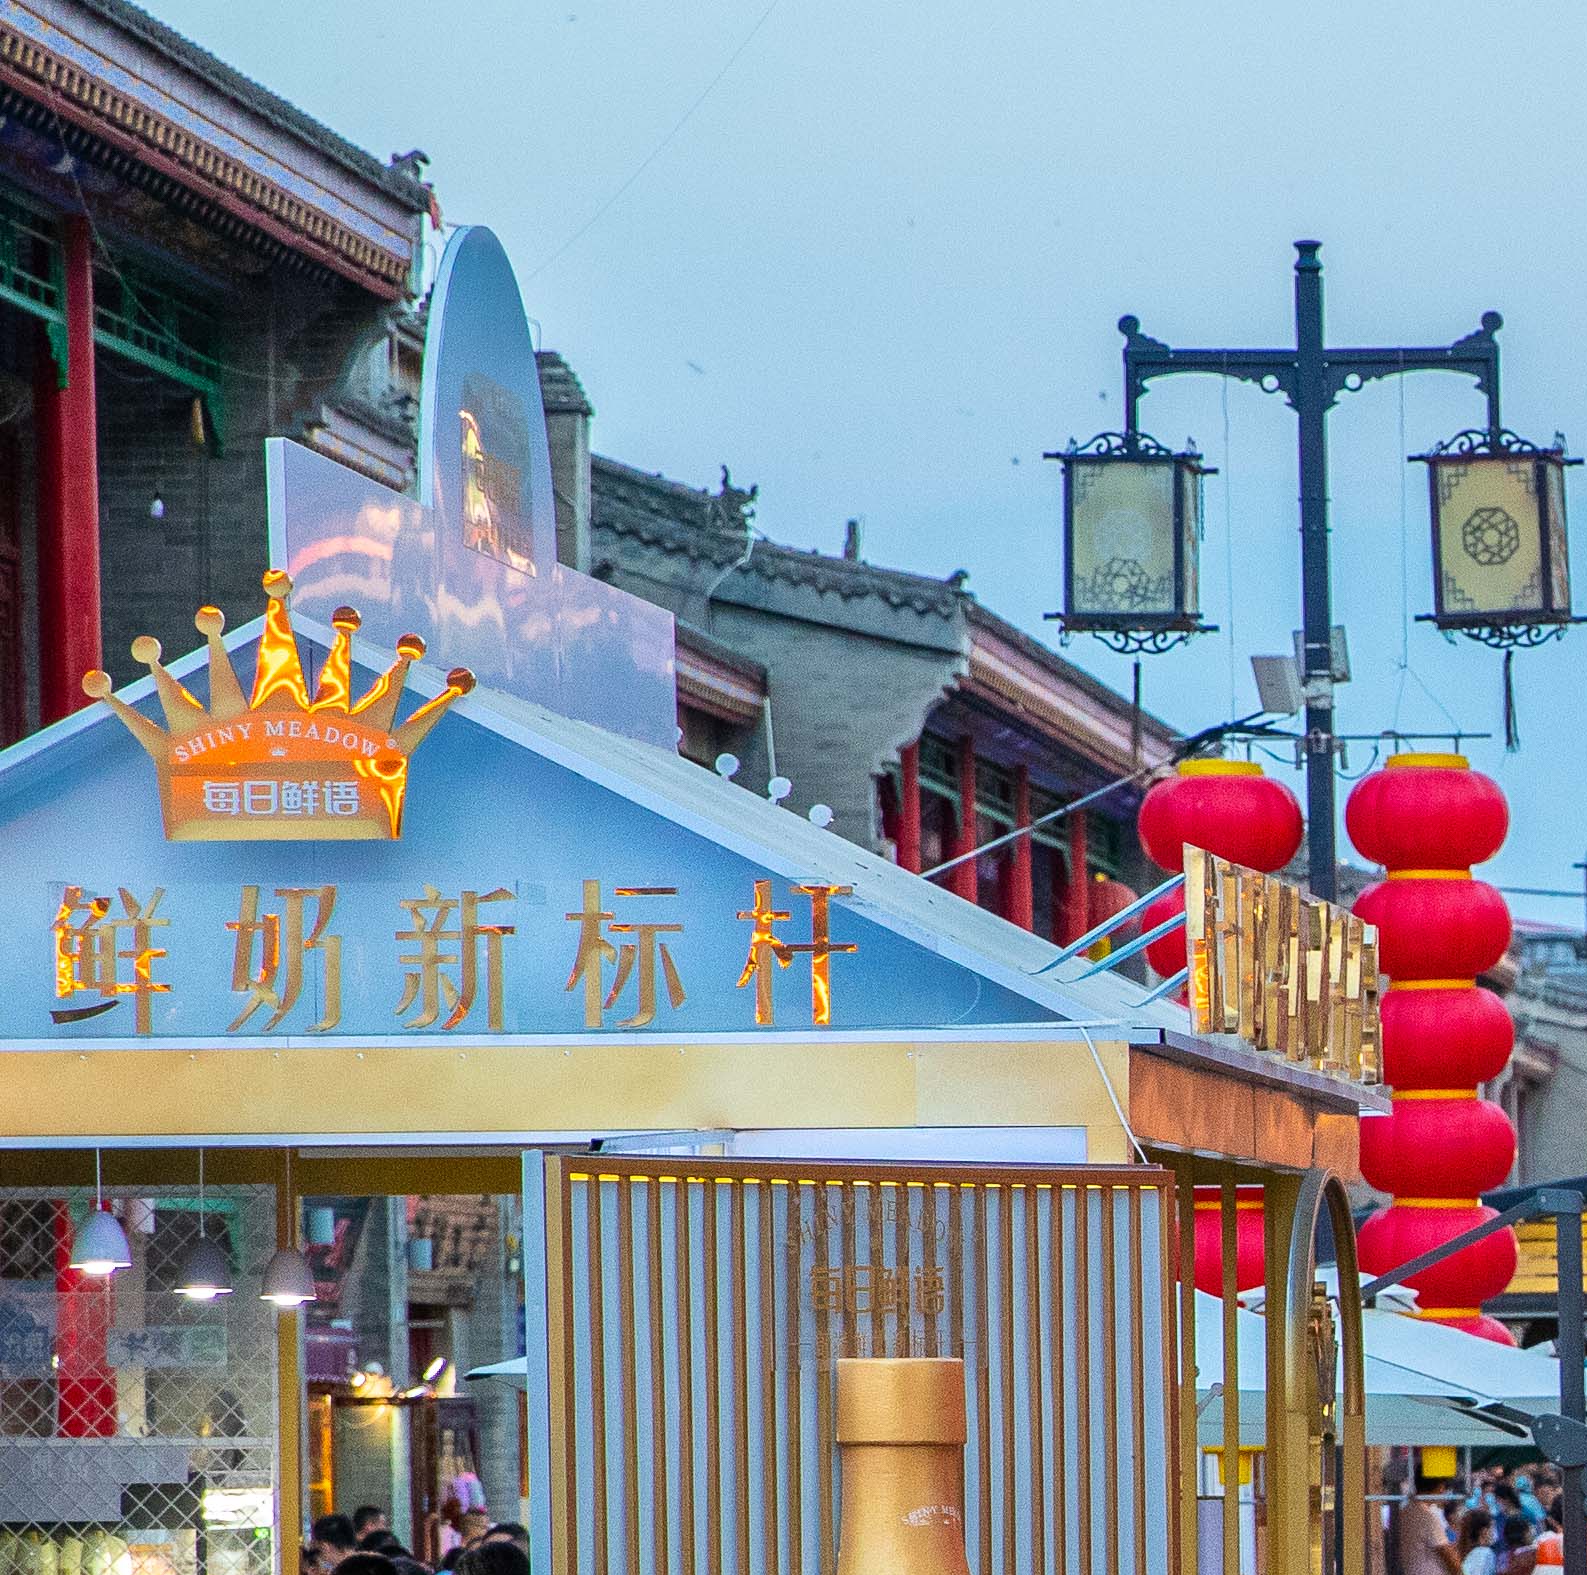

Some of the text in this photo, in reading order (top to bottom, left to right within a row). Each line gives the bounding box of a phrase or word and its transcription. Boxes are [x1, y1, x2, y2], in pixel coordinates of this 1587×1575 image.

[173, 719, 382, 763] SHINY MEADOW
[202, 779, 360, 815] 每日鲜语
[49, 879, 859, 1035] 鲜奶新标杆
